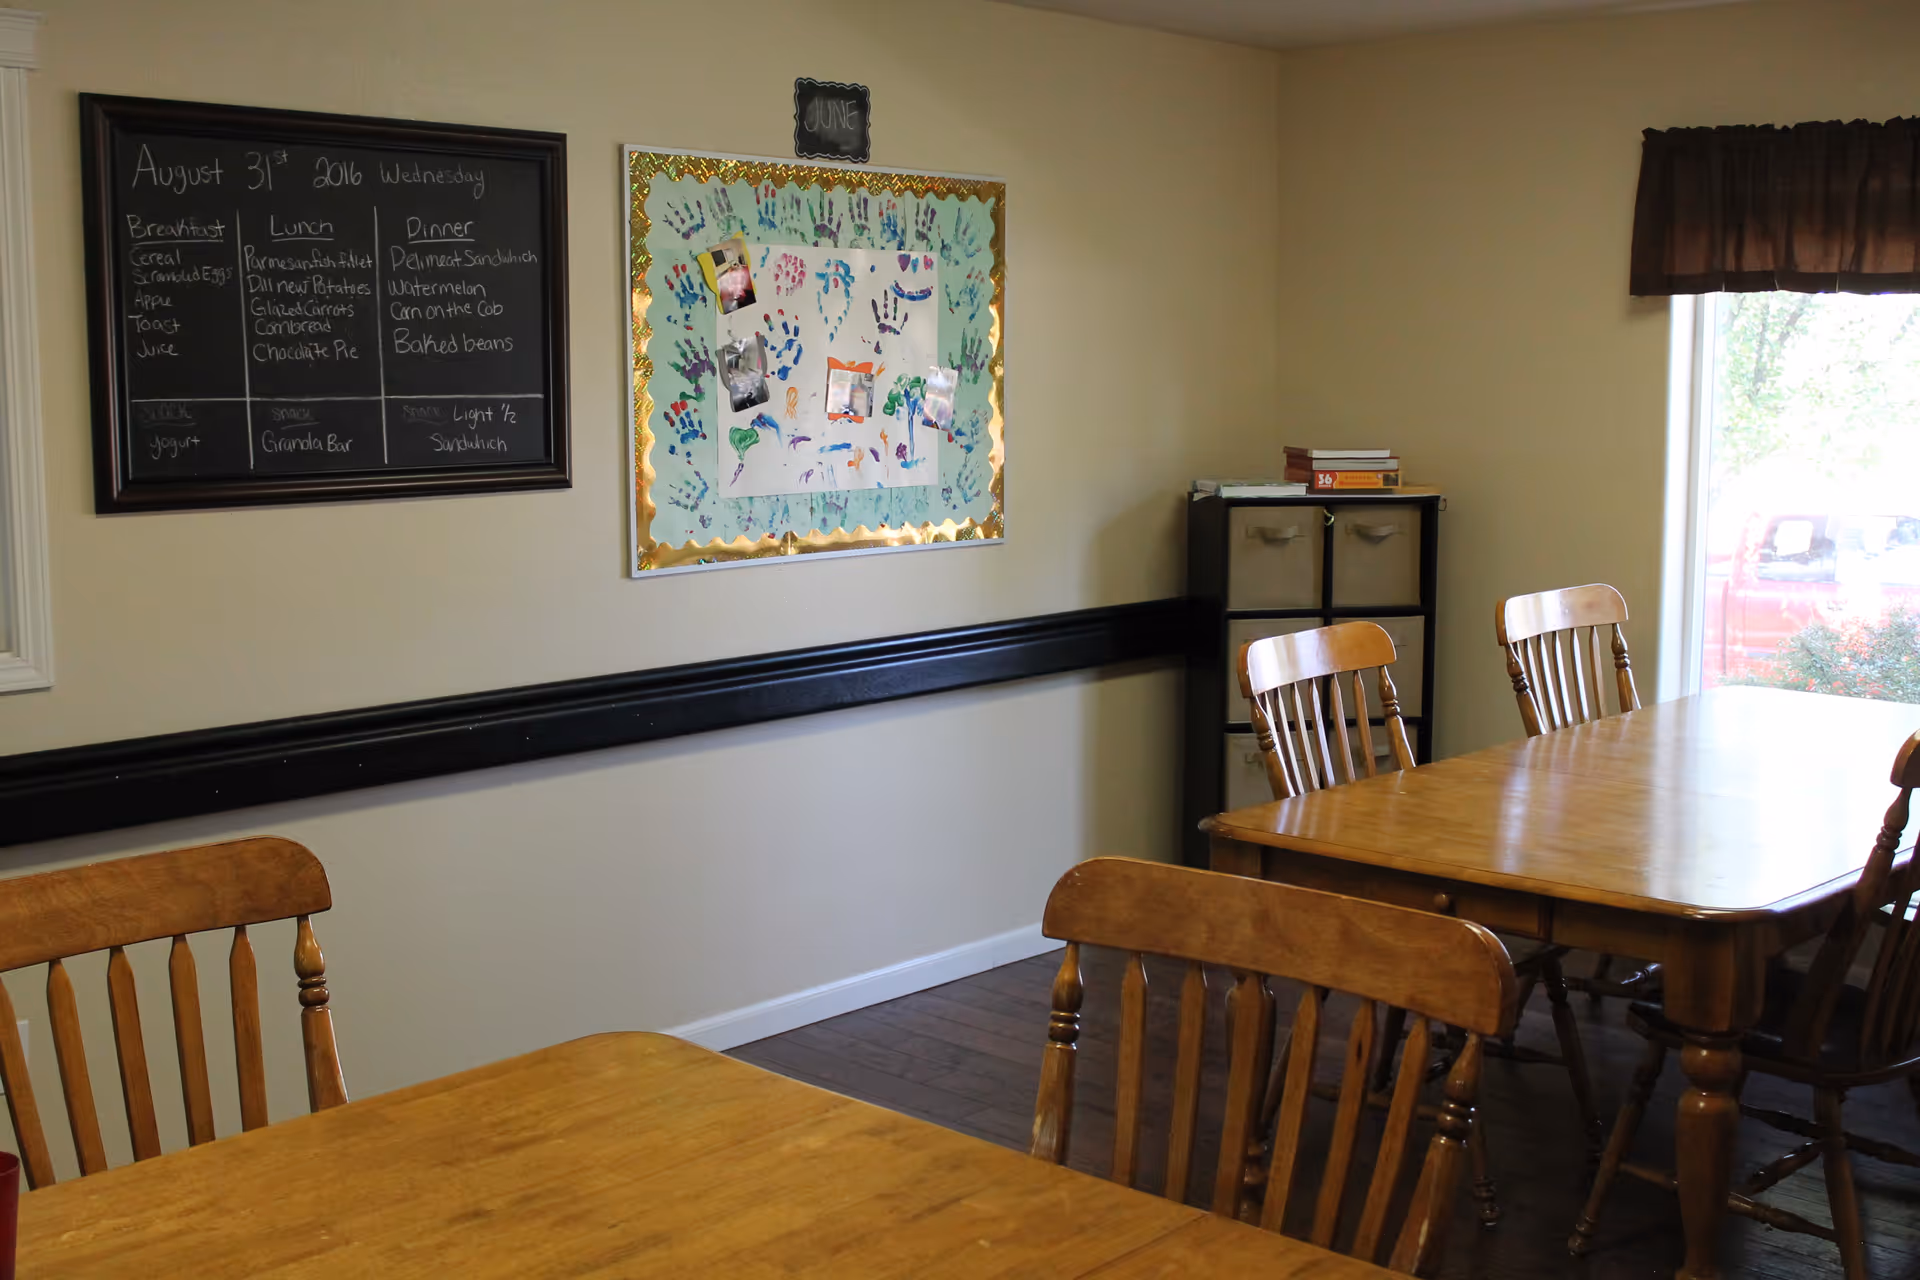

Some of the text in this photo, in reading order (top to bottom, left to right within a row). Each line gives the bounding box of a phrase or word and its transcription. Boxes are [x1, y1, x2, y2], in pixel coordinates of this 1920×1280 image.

[804, 96, 858, 132] JUNE
[132, 143, 485, 200] August 31st 2016 Wednesday
[126, 213, 226, 240] Breakfast
[269, 214, 334, 236] Lunch
[406, 216, 474, 240] Dinner
[129, 247, 181, 267] Cereal
[246, 274, 274, 293] Dill
[312, 274, 372, 295] Potatoes
[387, 275, 487, 297] Watermelon
[134, 290, 173, 310] Apple
[250, 296, 355, 317] Glazed Carrots
[390, 301, 422, 321] Corn
[446, 302, 473, 319] the
[477, 300, 504, 317] Cob
[127, 312, 181, 335] Toast
[137, 338, 179, 358] Juice
[332, 339, 359, 361] Pie
[393, 327, 514, 355] Baked beans
[452, 405, 494, 430] Light
[261, 429, 353, 453] Granola Bar
